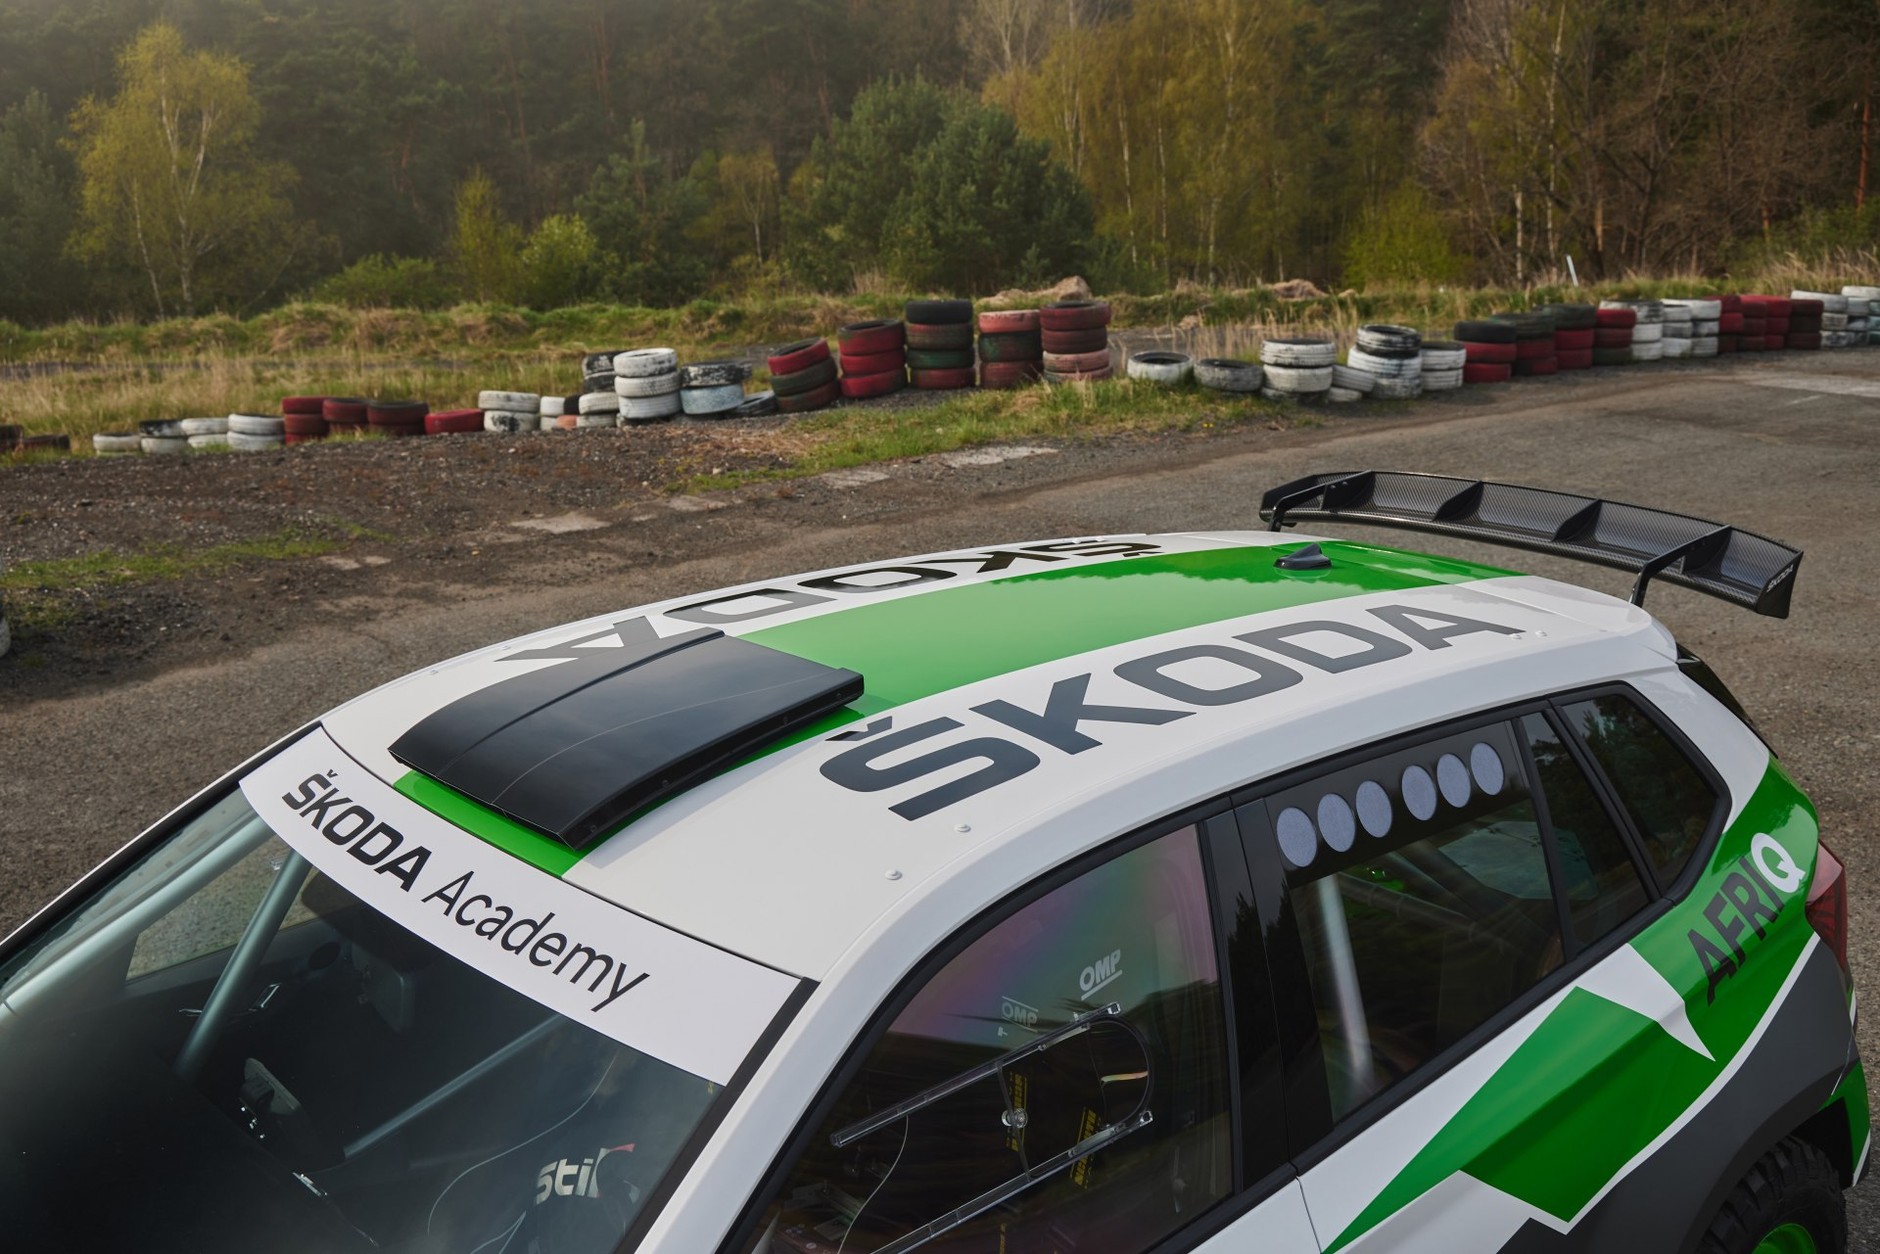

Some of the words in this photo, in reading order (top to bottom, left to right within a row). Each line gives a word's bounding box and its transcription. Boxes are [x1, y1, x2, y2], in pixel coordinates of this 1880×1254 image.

[819, 604, 1527, 821] ŠKODA
[281, 769, 432, 892] ŠKODA
[422, 870, 650, 1012] Academy
[1079, 949, 1121, 991] OMP
[1687, 832, 1806, 1007] AFRIQ
[1001, 1001, 1038, 1027] OMP
